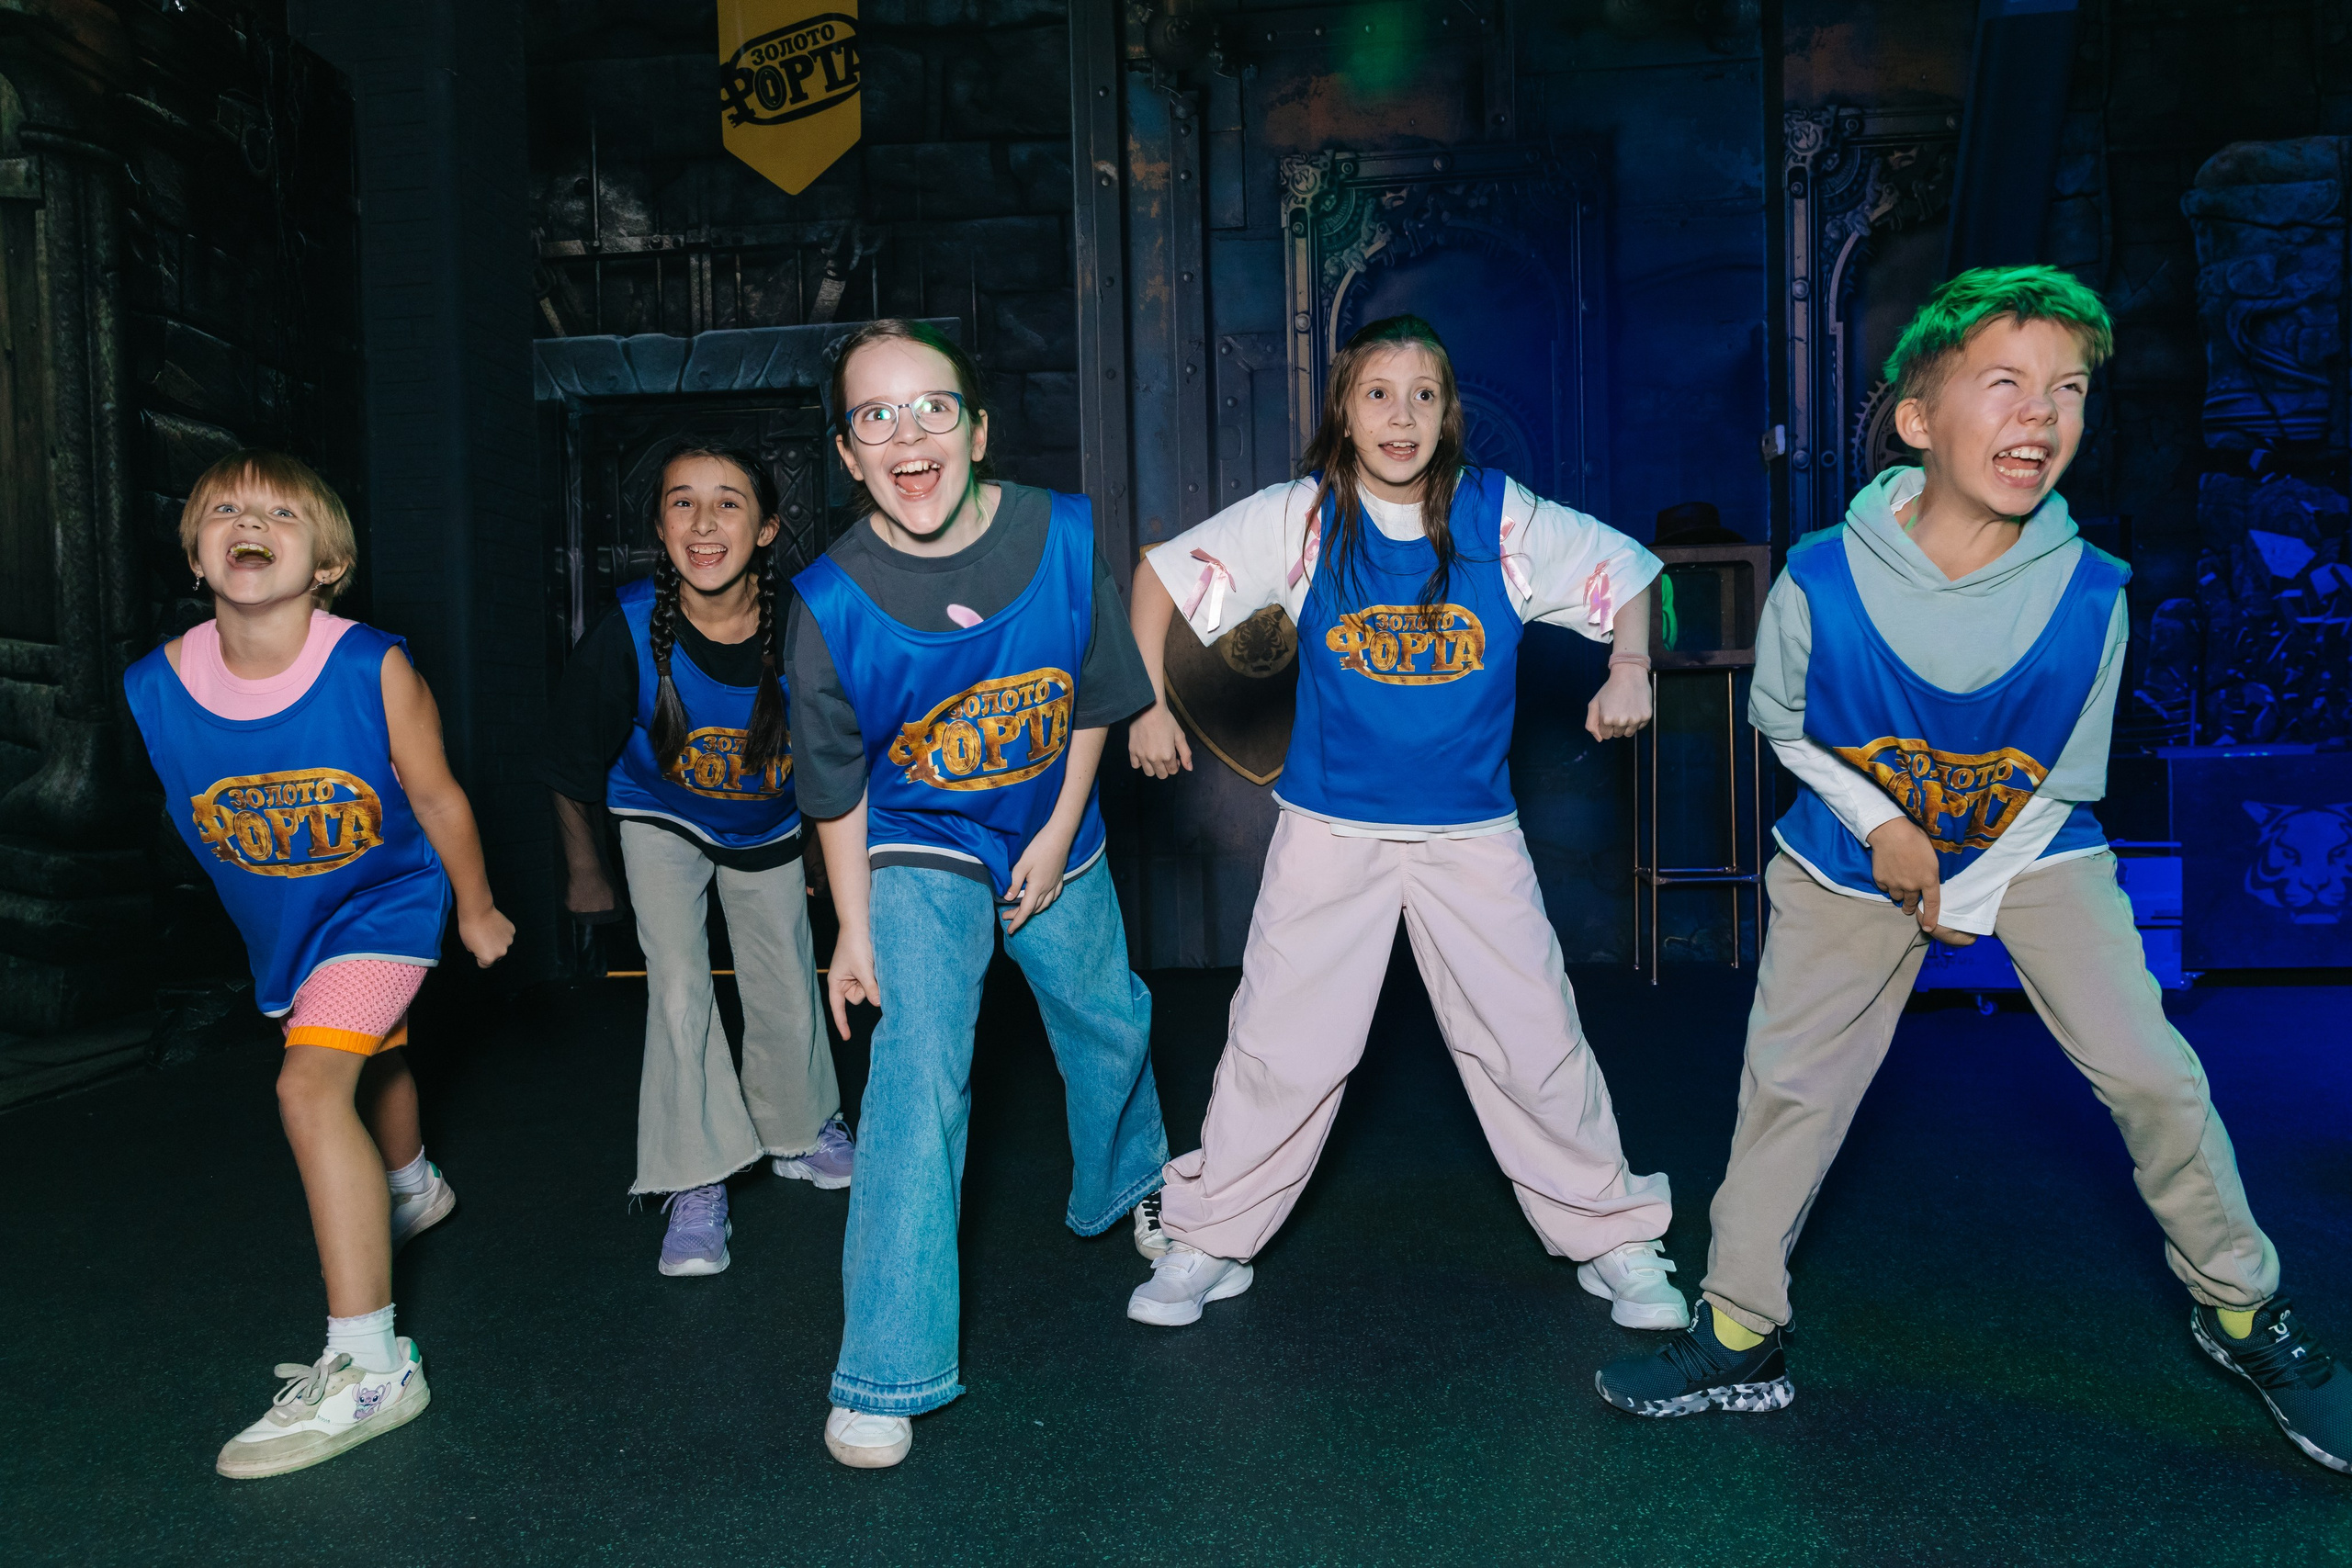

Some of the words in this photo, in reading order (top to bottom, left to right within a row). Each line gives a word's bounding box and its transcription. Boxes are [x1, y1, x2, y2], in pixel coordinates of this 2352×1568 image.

[751, 24, 835, 65] ЗОЛОТО
[1326, 615, 1484, 671] ФОРТА
[703, 736, 748, 754] ЗОЛ
[888, 694, 1072, 784] ФОРТА
[229, 781, 334, 809] ЗОЛОТО
[190, 794, 384, 863] ФОРТА
